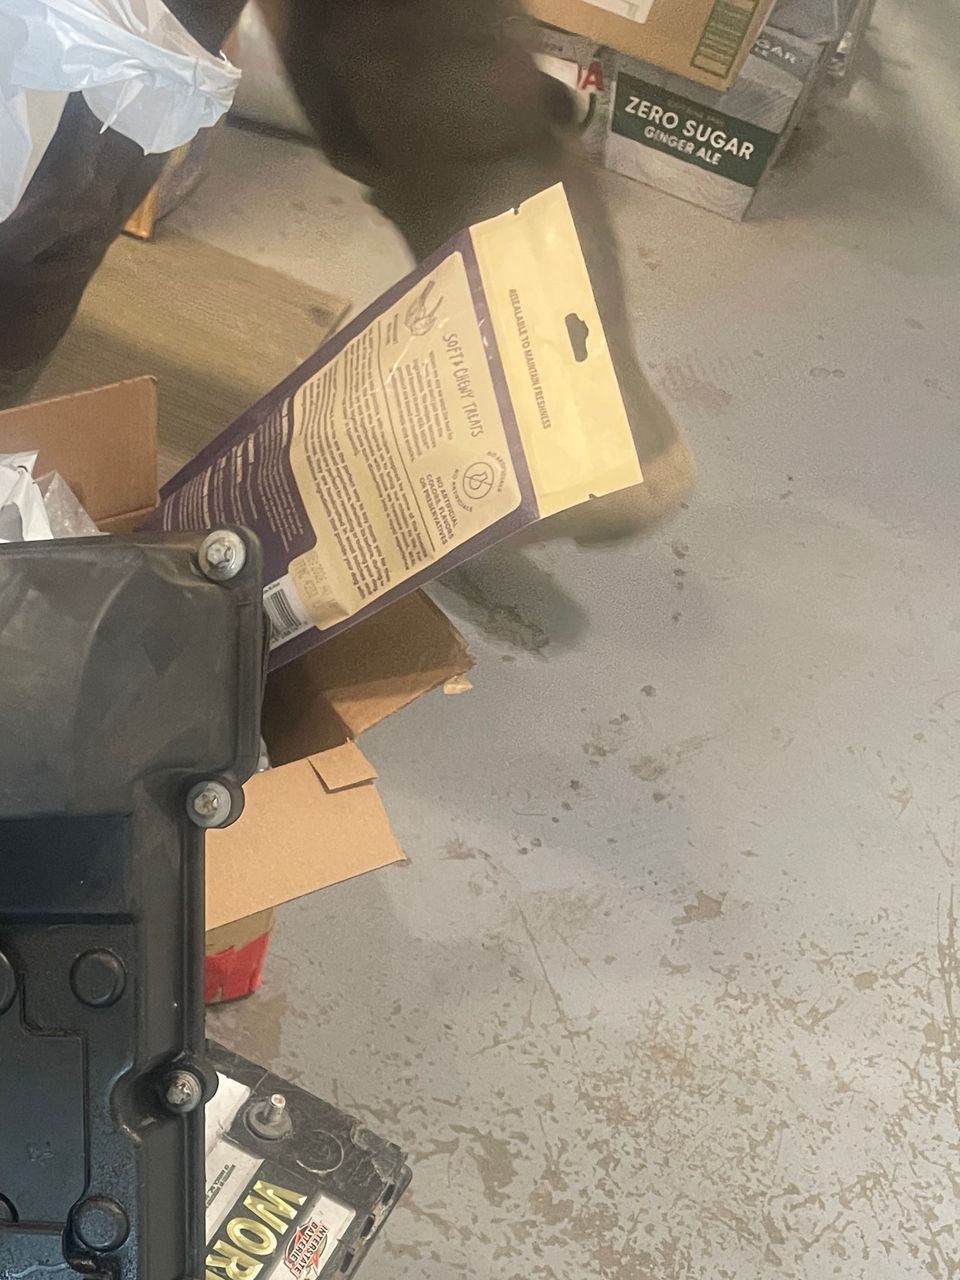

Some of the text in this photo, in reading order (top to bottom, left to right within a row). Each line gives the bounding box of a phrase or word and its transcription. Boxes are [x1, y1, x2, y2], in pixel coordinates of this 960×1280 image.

[624, 95, 680, 130] ZERO
[681, 119, 756, 162] SUGAR
[643, 124, 723, 167] GINGER ALE
[442, 332, 464, 362] SOFT
[508, 288, 552, 430] RESEALABLE TO MAINTAIN FRESHNESS
[452, 367, 475, 401] CHEWY
[461, 401, 485, 438] TREATS
[417, 476, 428, 490] OR
[434, 476, 461, 528] NO ARTIFICIAL
[420, 489, 451, 545] PRESERVATIVES
[436, 506, 457, 540] FLAVORS
[289, 1221, 319, 1266] BATTERIES
[294, 1225, 328, 1275] INTERSTATE
